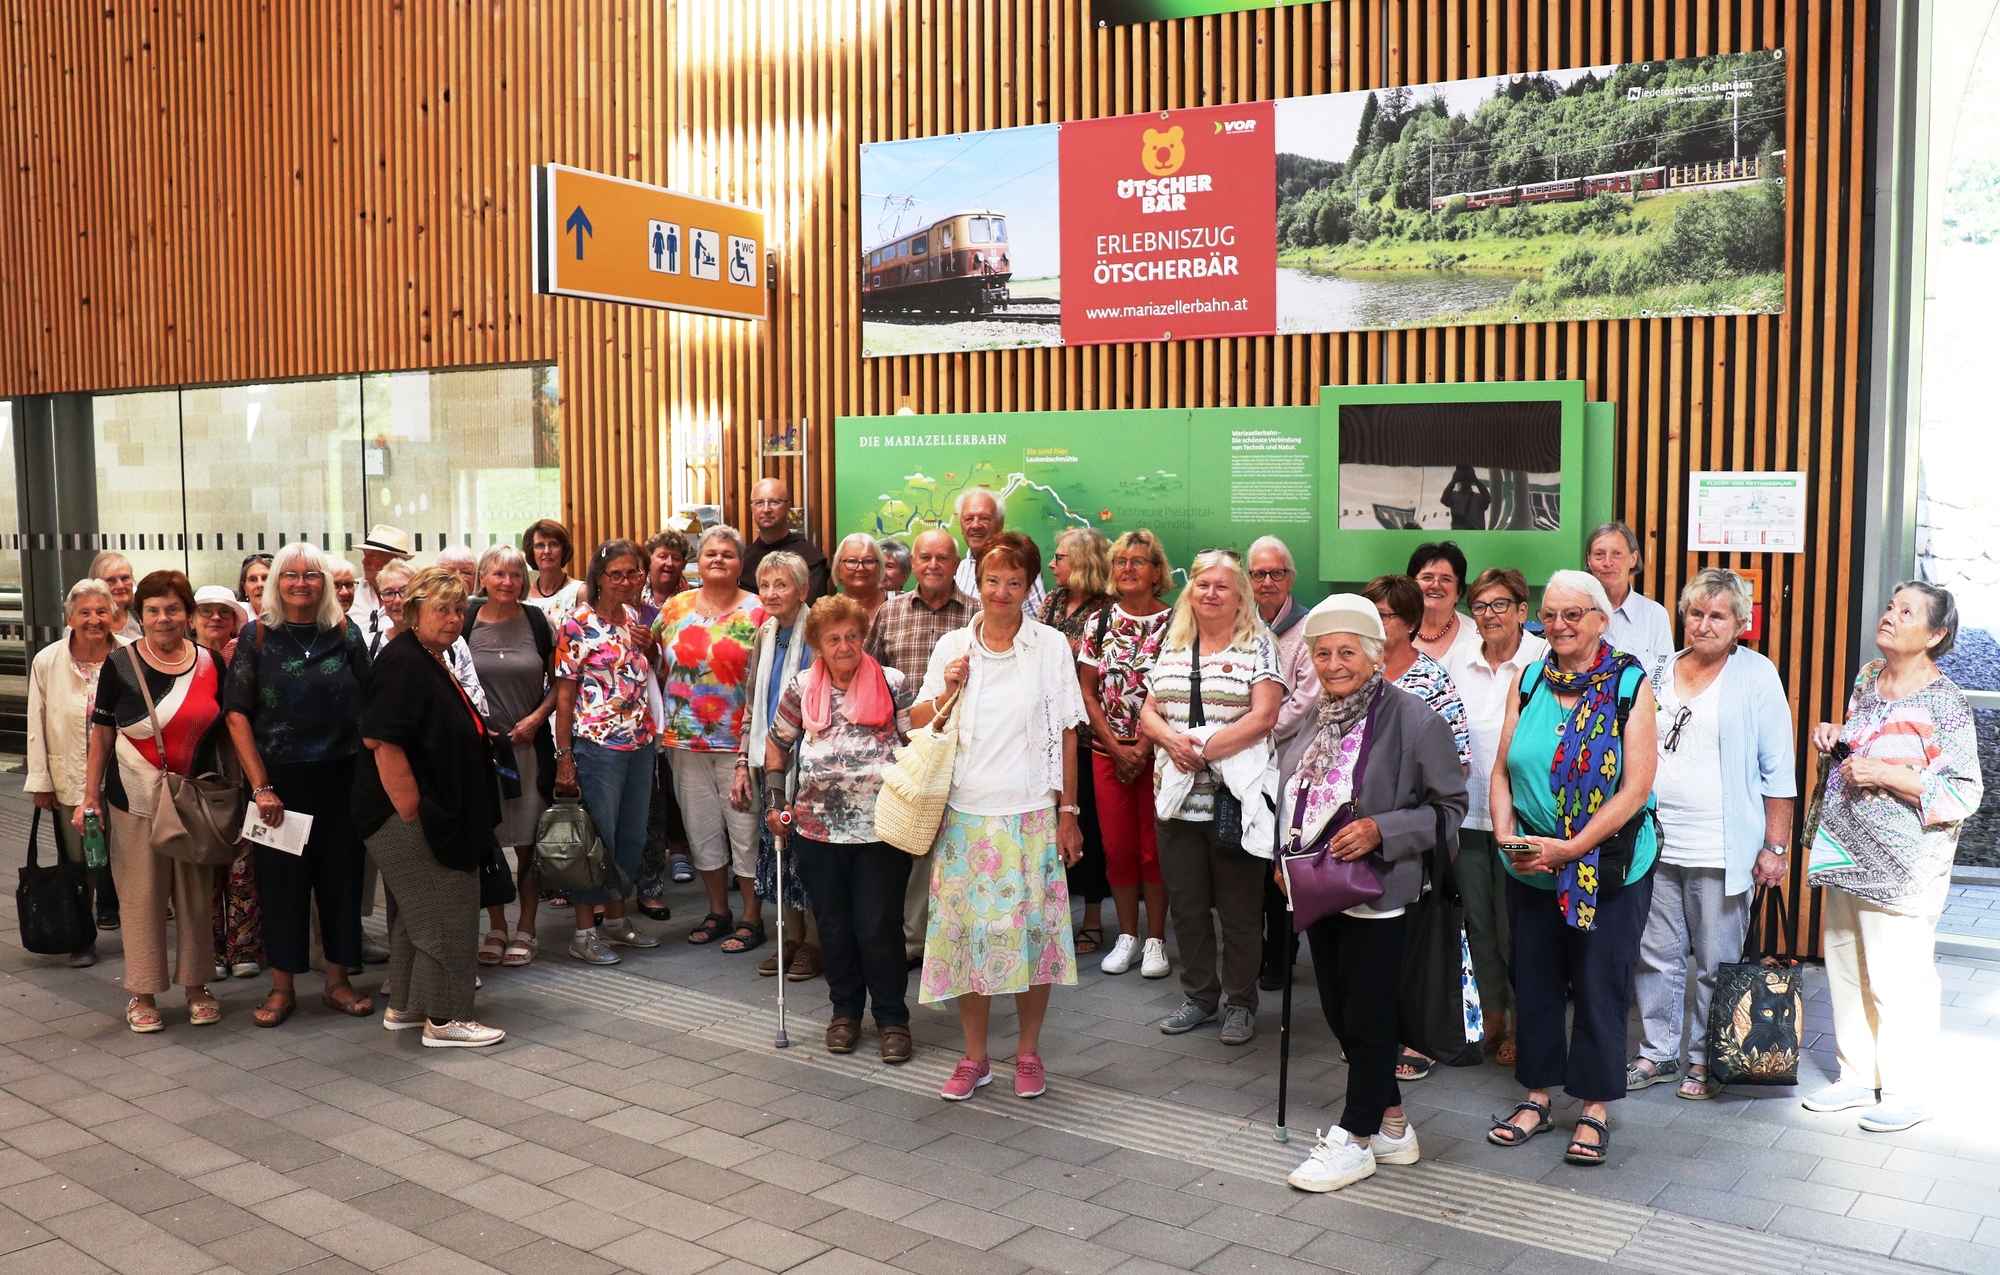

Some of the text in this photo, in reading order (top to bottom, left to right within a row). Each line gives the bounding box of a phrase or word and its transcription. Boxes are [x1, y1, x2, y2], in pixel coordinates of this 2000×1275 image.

[1627, 80, 1753, 100] Niederösterreich Bahnen
[1223, 119, 1257, 131] VOR
[1117, 174, 1212, 198] ÖTSCHER
[1142, 194, 1186, 214] BÄR
[1096, 225, 1235, 256] ERLEBNISZUG
[741, 242, 754, 254] WC
[1094, 252, 1239, 285] ÖTSCHERBÄR
[1086, 297, 1248, 320] www.mariazellerbahn.at
[859, 433, 1007, 447] DIE MARIAZELLERBAHN
[1268, 436, 1302, 444] Verbindung
[1026, 447, 1069, 455] Sie sind hier
[1026, 455, 1079, 463] Laubenbachmühle
[1116, 506, 1162, 517] Talstrecke
[1136, 519, 1152, 529] das
